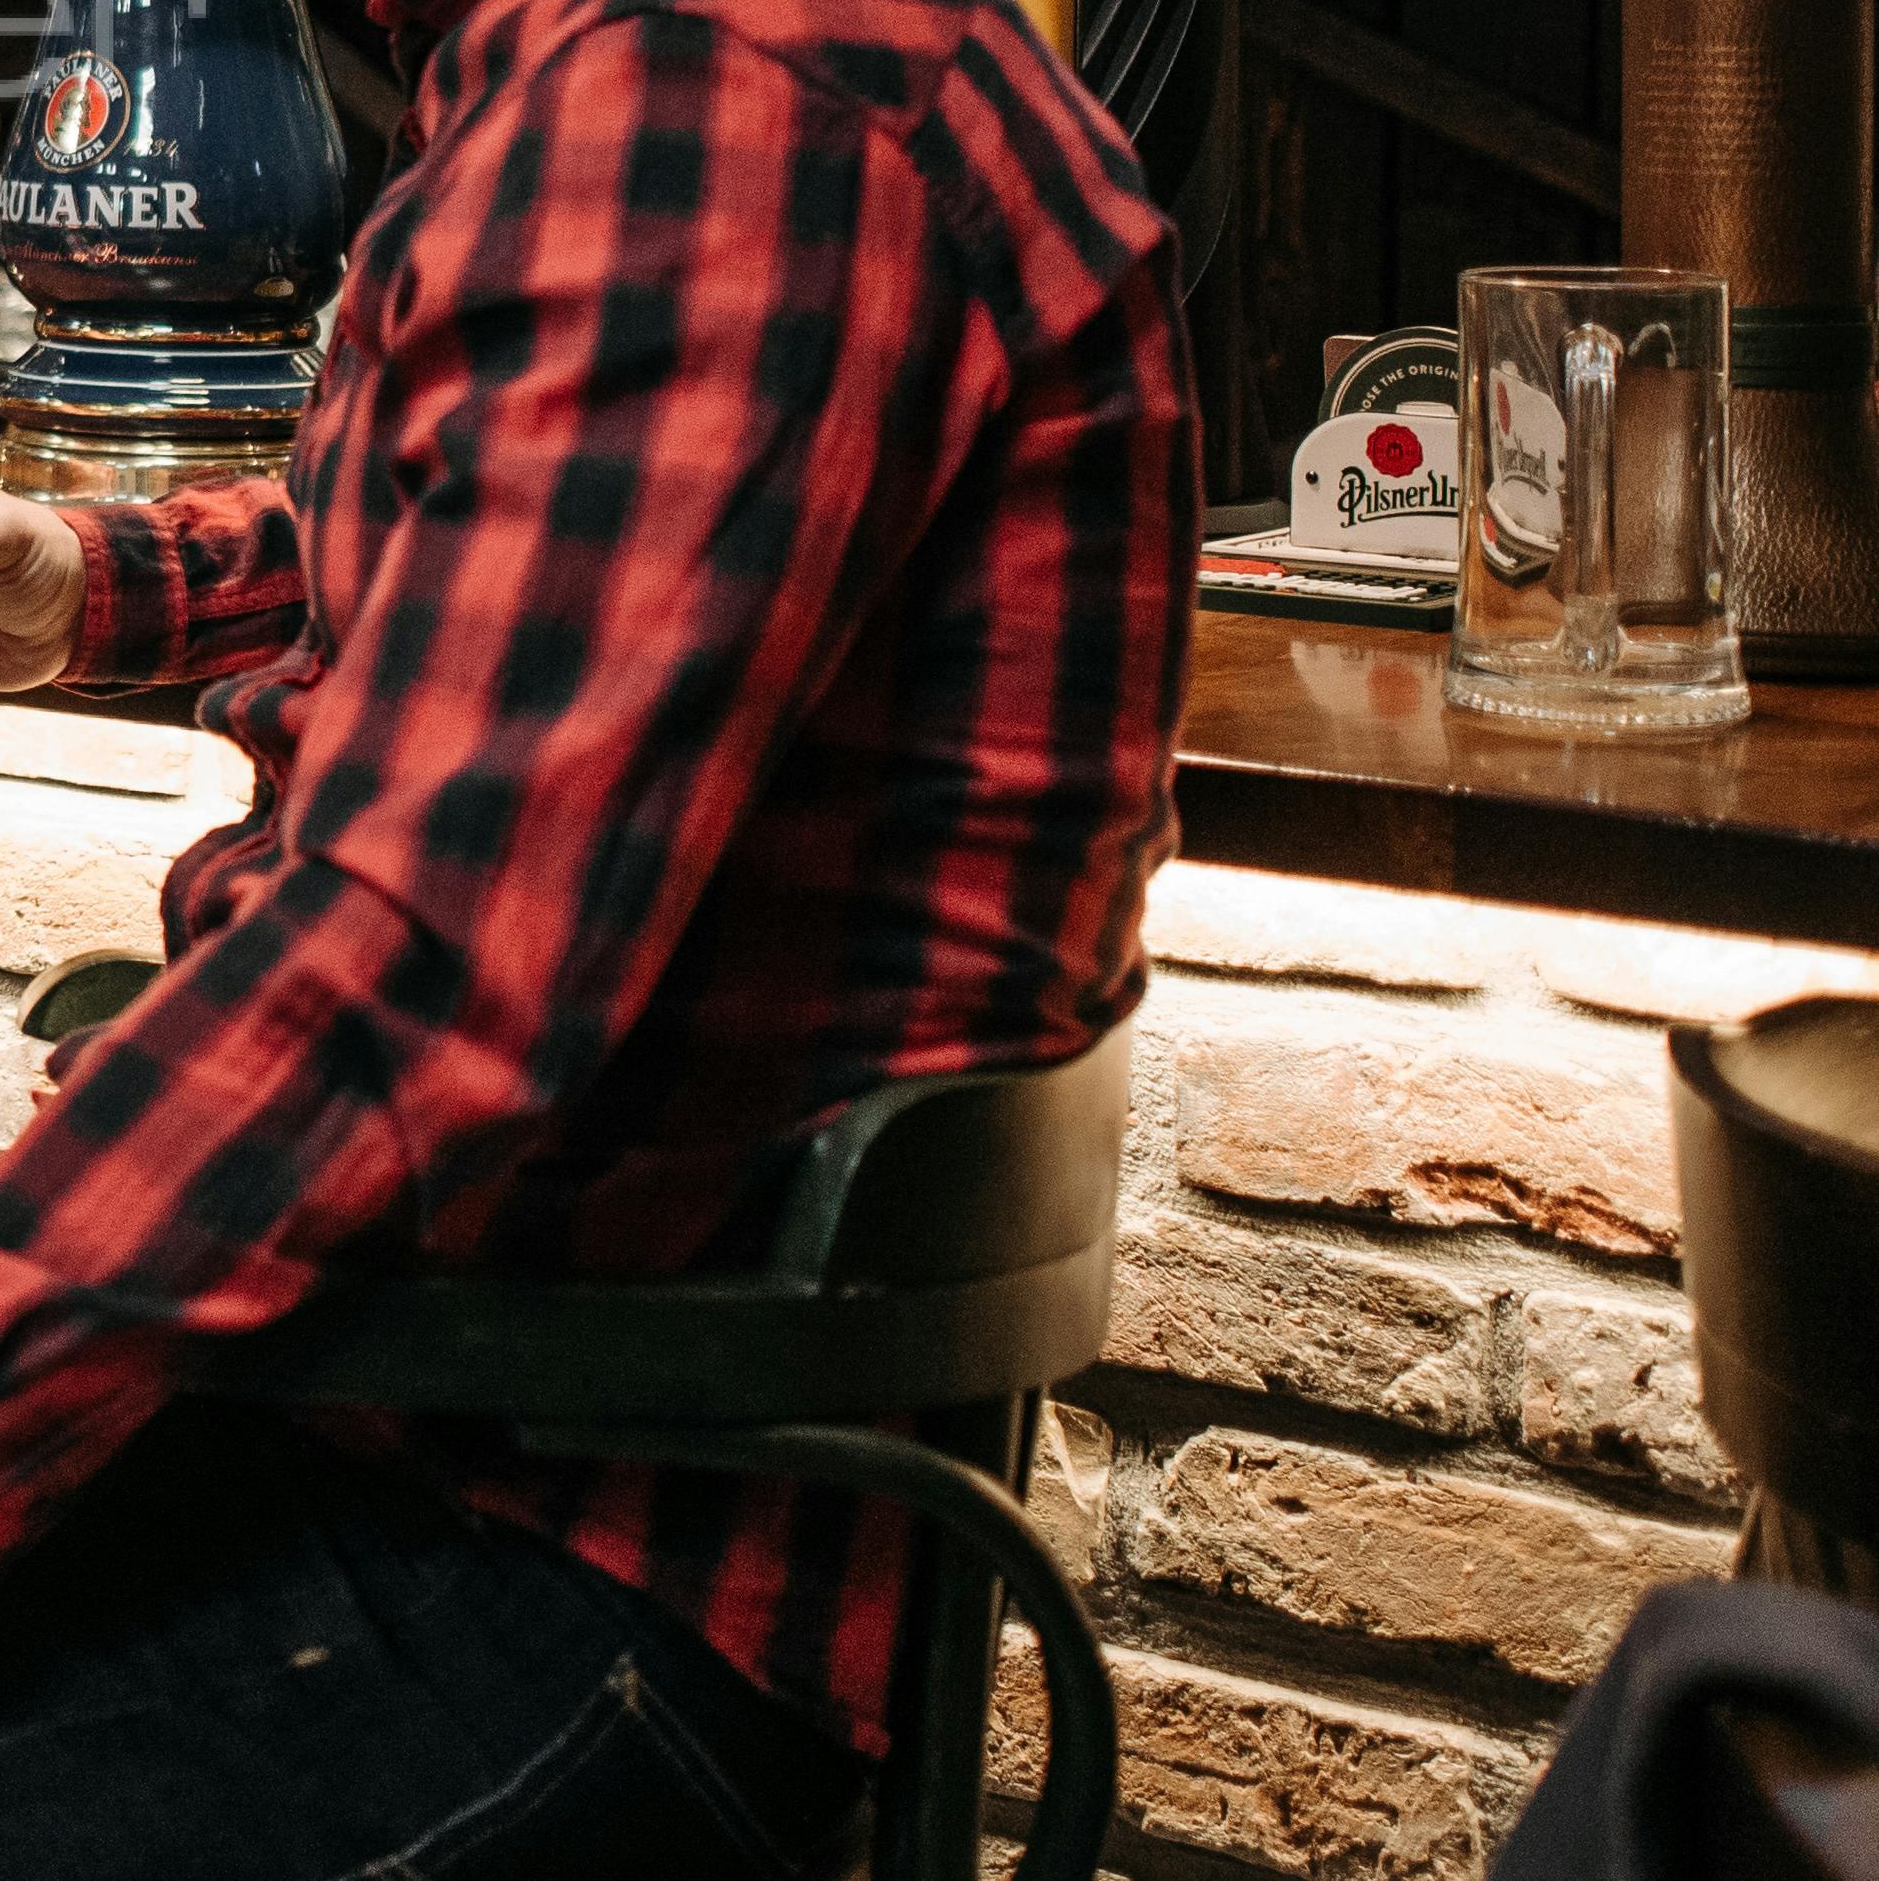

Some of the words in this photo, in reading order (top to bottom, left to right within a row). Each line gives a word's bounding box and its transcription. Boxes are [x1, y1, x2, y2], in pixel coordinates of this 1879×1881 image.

[45, 57, 124, 103] PAULANER
[123, 137, 180, 165] 134
[1360, 385, 1380, 411] OSE
[1380, 369, 1405, 386] THE
[1409, 364, 1459, 380] ORIGIN
